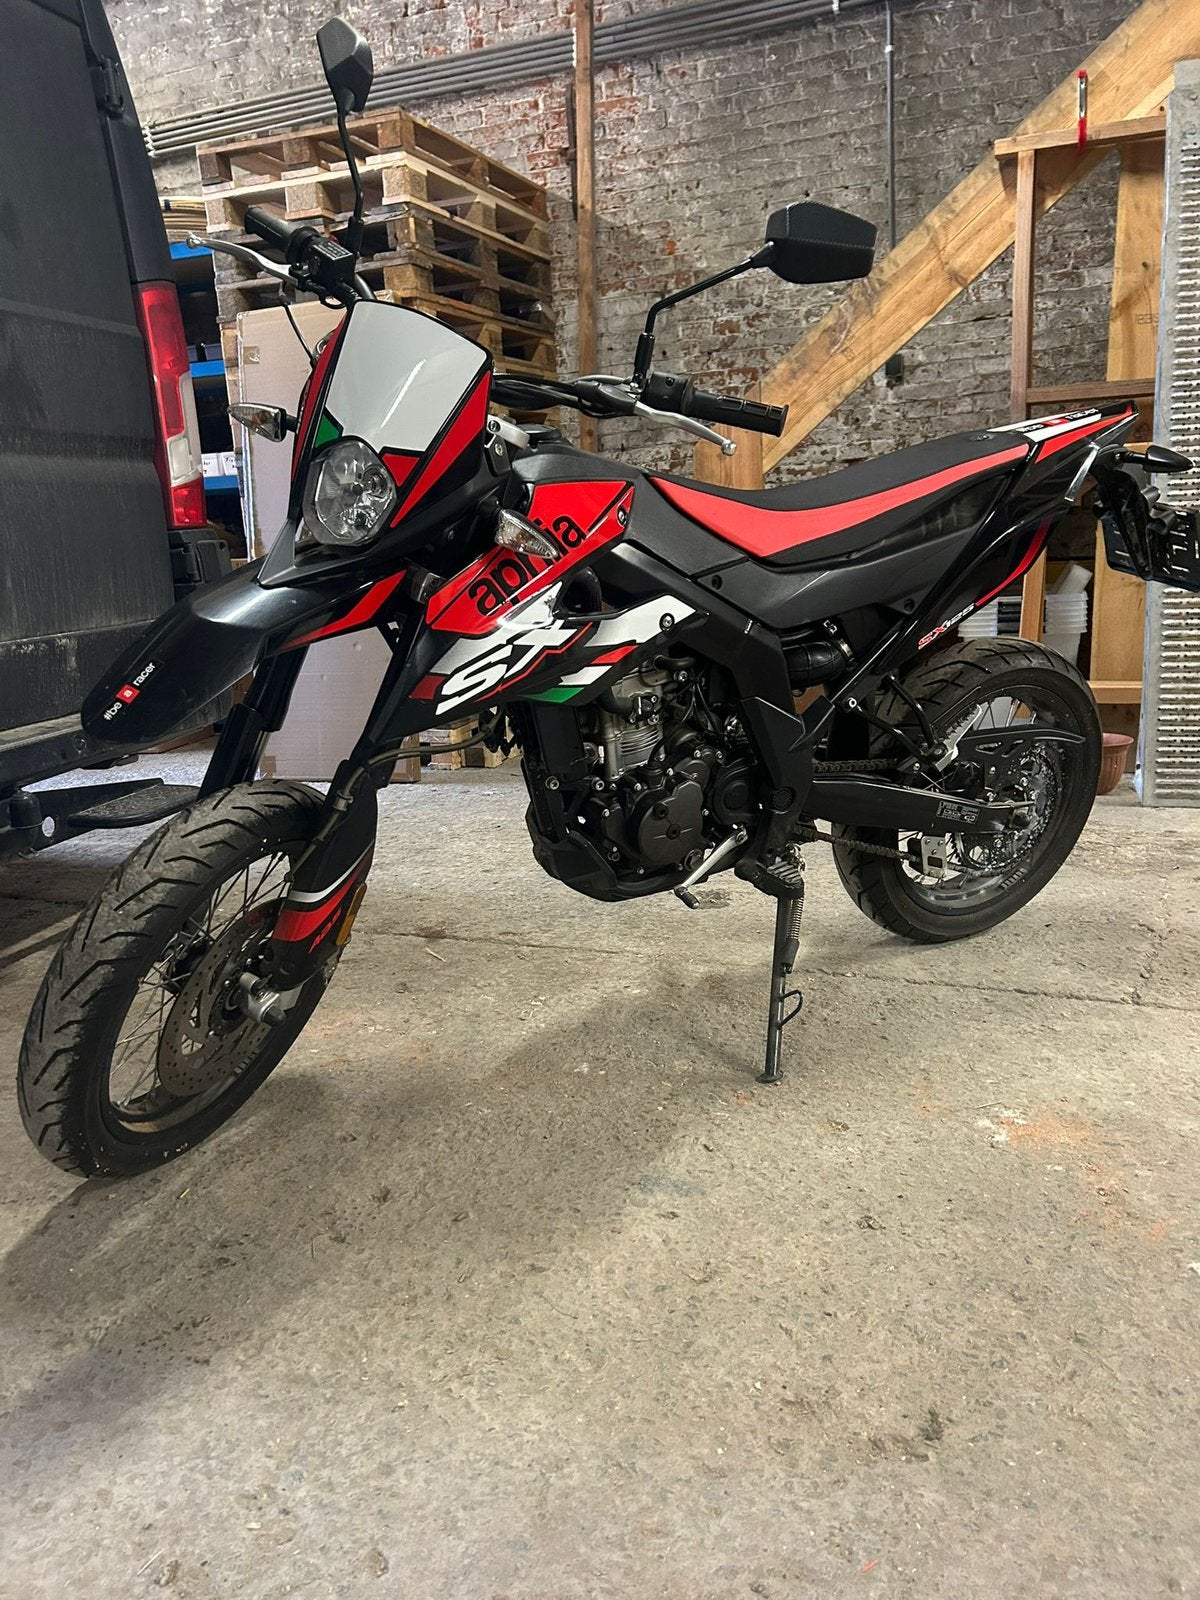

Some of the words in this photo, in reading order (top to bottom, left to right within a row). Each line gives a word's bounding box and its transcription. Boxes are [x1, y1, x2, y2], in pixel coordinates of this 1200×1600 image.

[468, 515, 586, 617] apria
[103, 701, 122, 721] #be
[133, 662, 156, 687] racer
[435, 619, 578, 715] SX
